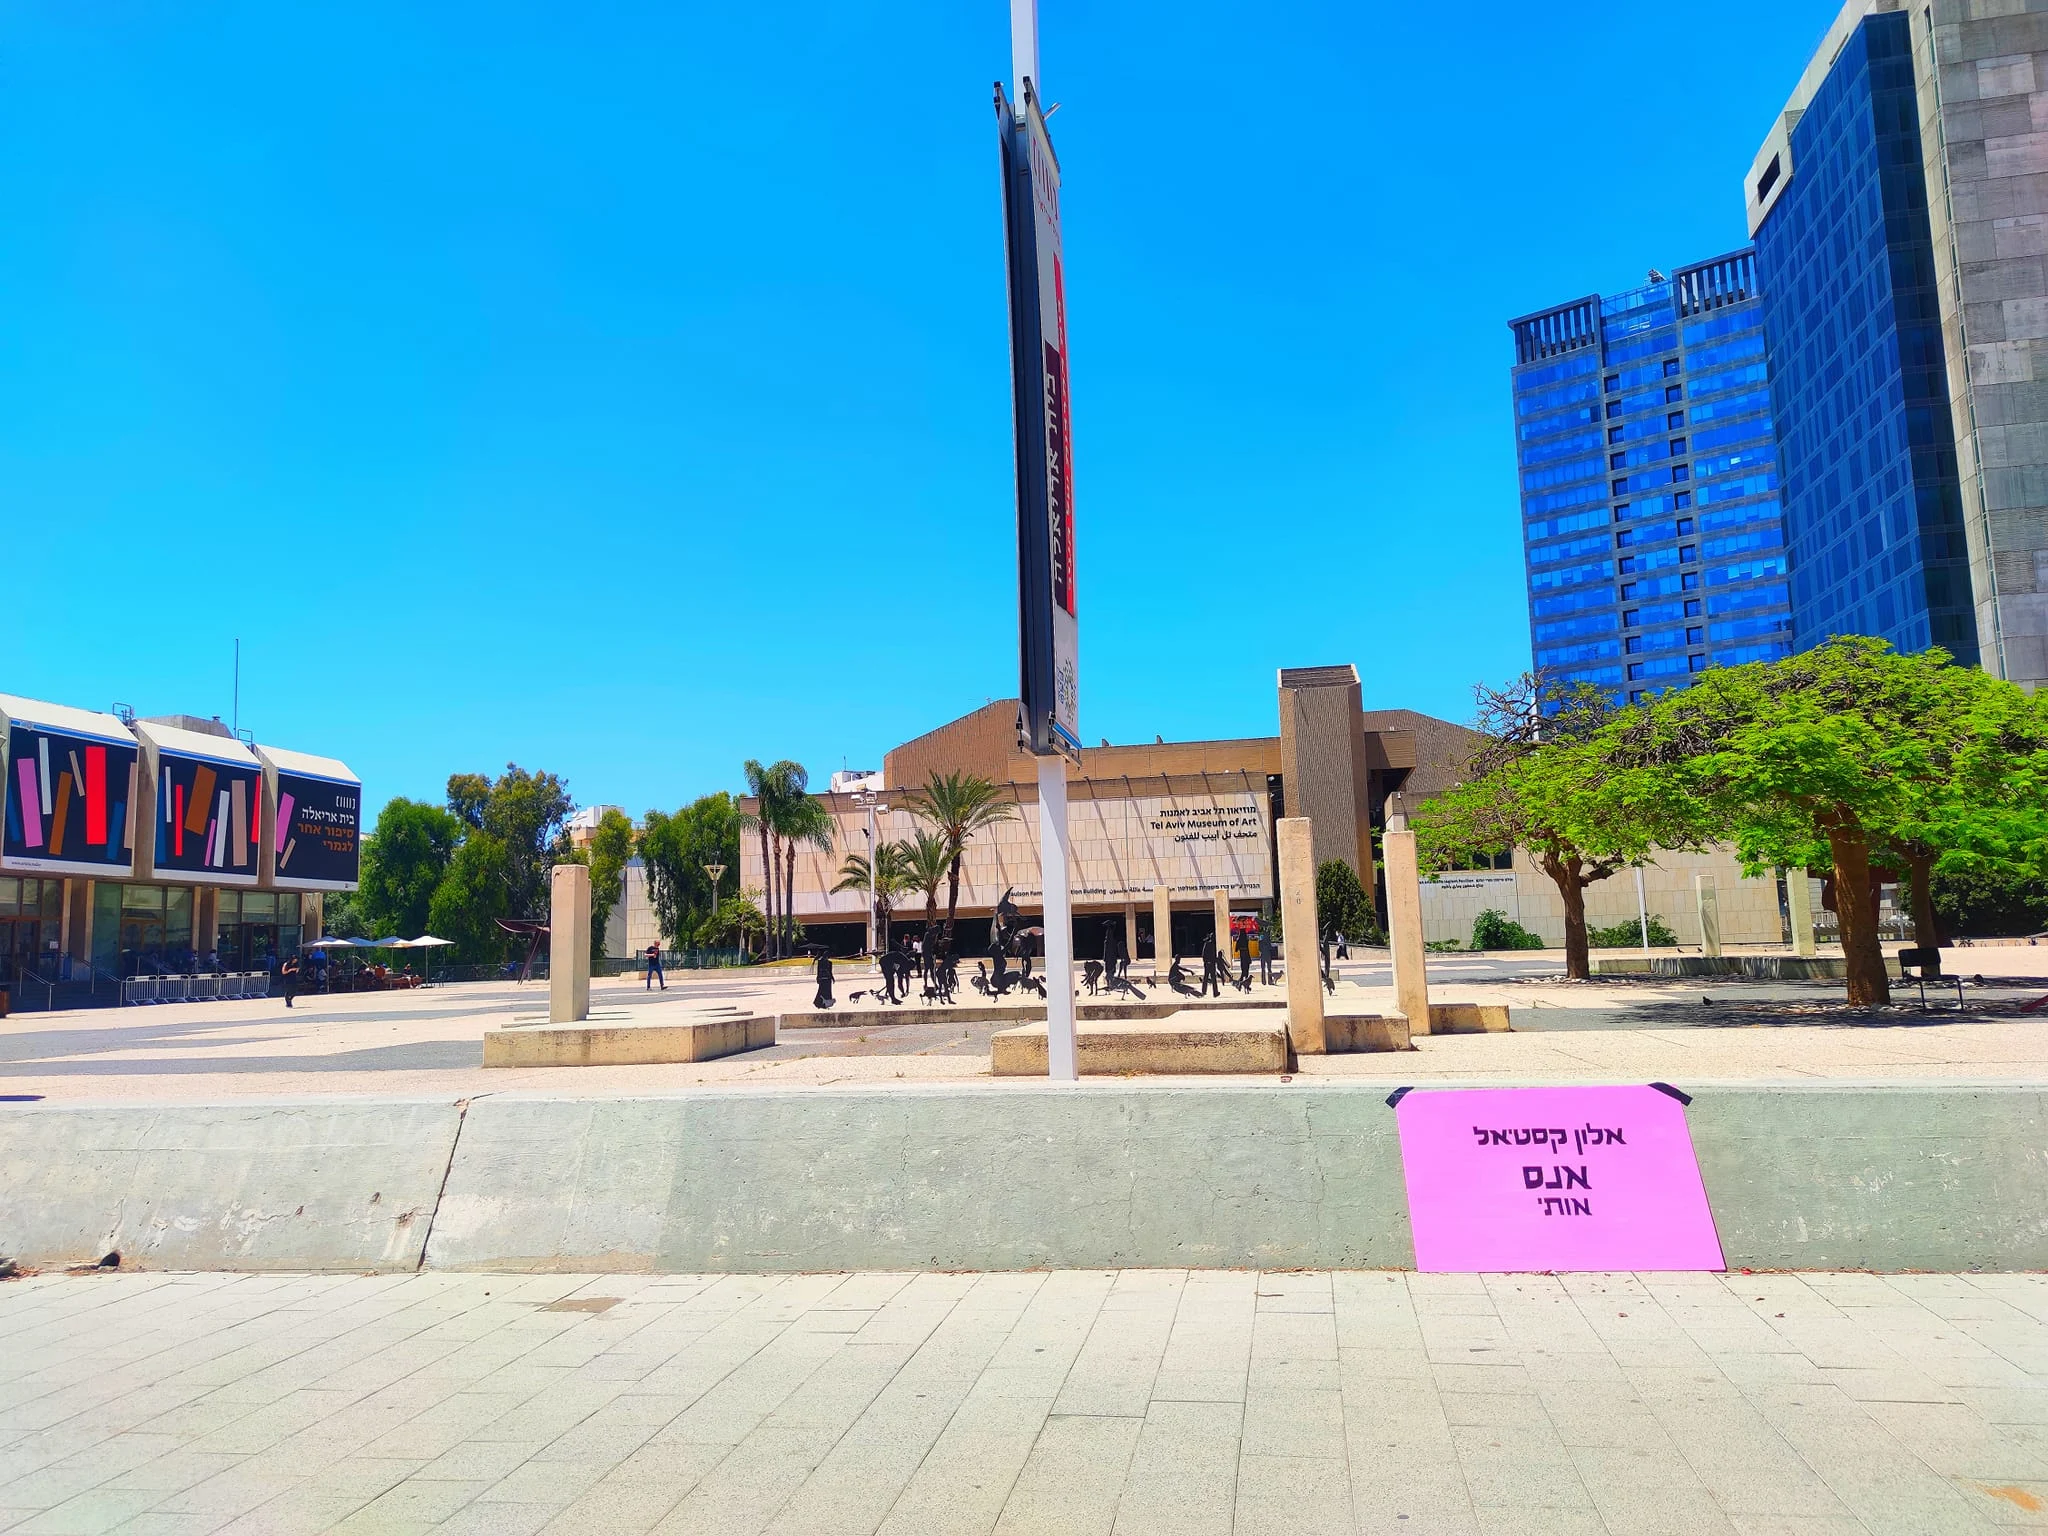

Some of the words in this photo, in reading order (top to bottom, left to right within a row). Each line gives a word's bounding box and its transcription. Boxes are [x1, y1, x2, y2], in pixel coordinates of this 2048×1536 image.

[302, 805, 338, 822] אריאלה
[1160, 808, 1189, 817] לאמנות
[1192, 808, 1212, 816] אביב
[1227, 806, 1256, 815] מוזיאון
[339, 814, 355, 825] בית
[1151, 821, 1163, 830] Tel
[1165, 821, 1185, 829] Aviv
[1187, 820, 1227, 828] Museum
[1229, 818, 1239, 826] of
[1242, 818, 1257, 826] Art
[325, 825, 354, 838] סיפור
[1175, 832, 1199, 842] للفنون
[1234, 831, 1257, 839] متحف
[322, 840, 354, 852] לגמרי
[1473, 1126, 1568, 1154] קסטיאל
[1575, 1123, 1627, 1155] אלון
[1522, 1166, 1592, 1190] אנס
[1538, 1197, 1592, 1216] אותי
